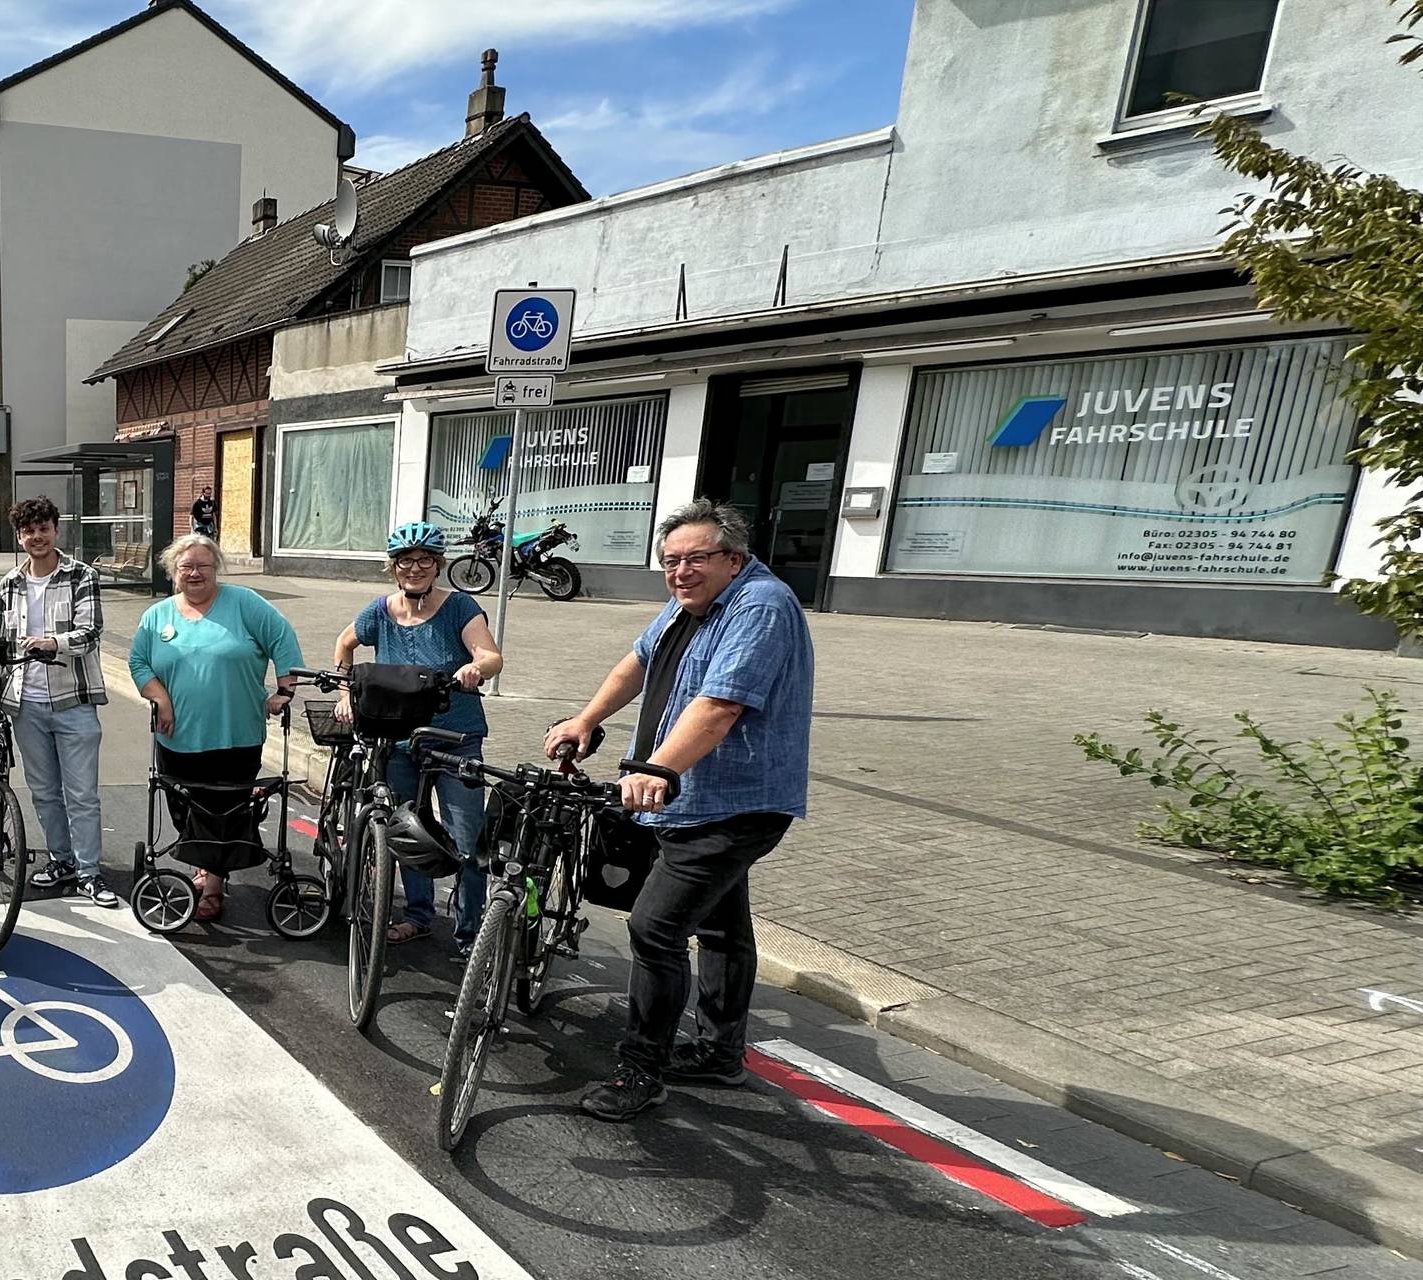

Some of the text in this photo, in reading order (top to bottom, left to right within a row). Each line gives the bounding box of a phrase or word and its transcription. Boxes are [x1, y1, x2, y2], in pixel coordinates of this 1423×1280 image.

[493, 356, 563, 366] Fahrradstraße
[523, 385, 548, 398] frei
[1076, 382, 1235, 417] JUVENS
[1049, 417, 1255, 446] FAHRSCHULE
[1143, 529, 1175, 538] Büro:
[1178, 530, 1218, 538] 02305
[1230, 530, 1246, 538] 94
[1251, 530, 1275, 538] 744
[1279, 530, 1297, 538] 80
[1148, 541, 1172, 549] Fax:
[1248, 542, 1272, 550] 744
[1276, 542, 1293, 550] 81
[1117, 552, 1290, 562] info@juvens-fahrschule.de
[1117, 564, 1287, 575] www.juvens-fahrschule.de
